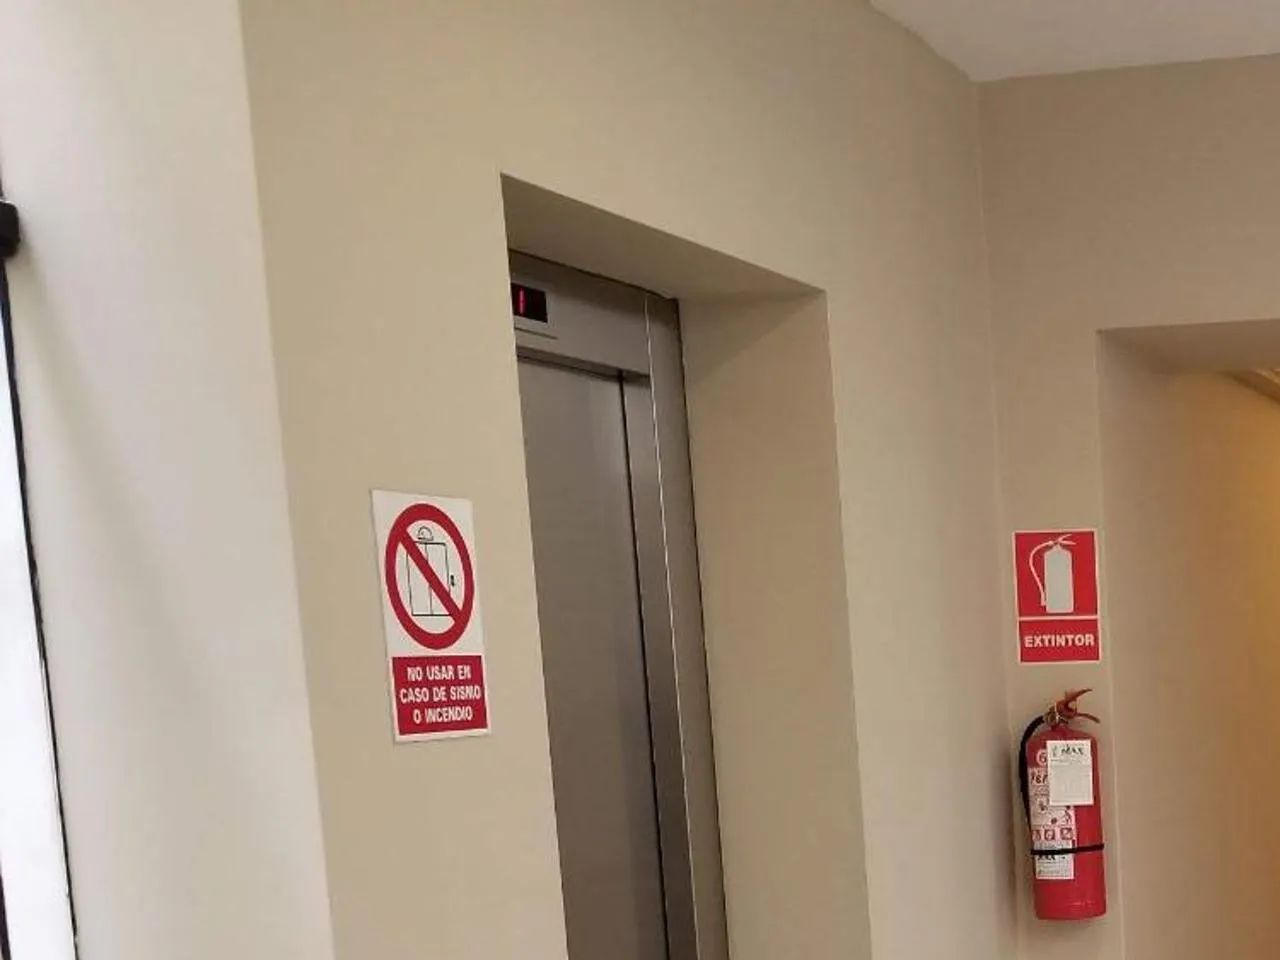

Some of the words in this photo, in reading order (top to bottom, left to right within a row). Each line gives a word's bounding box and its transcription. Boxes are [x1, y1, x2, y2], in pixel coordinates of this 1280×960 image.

[1024, 633, 1095, 648] EXTINTOR
[407, 666, 423, 682] NO
[426, 664, 455, 681] USAR
[457, 664, 472, 680] EN
[400, 687, 430, 704] CASO
[433, 686, 448, 702] DE
[450, 684, 482, 701] SISMO
[413, 709, 421, 725] O
[425, 705, 473, 724] INCENDIO
